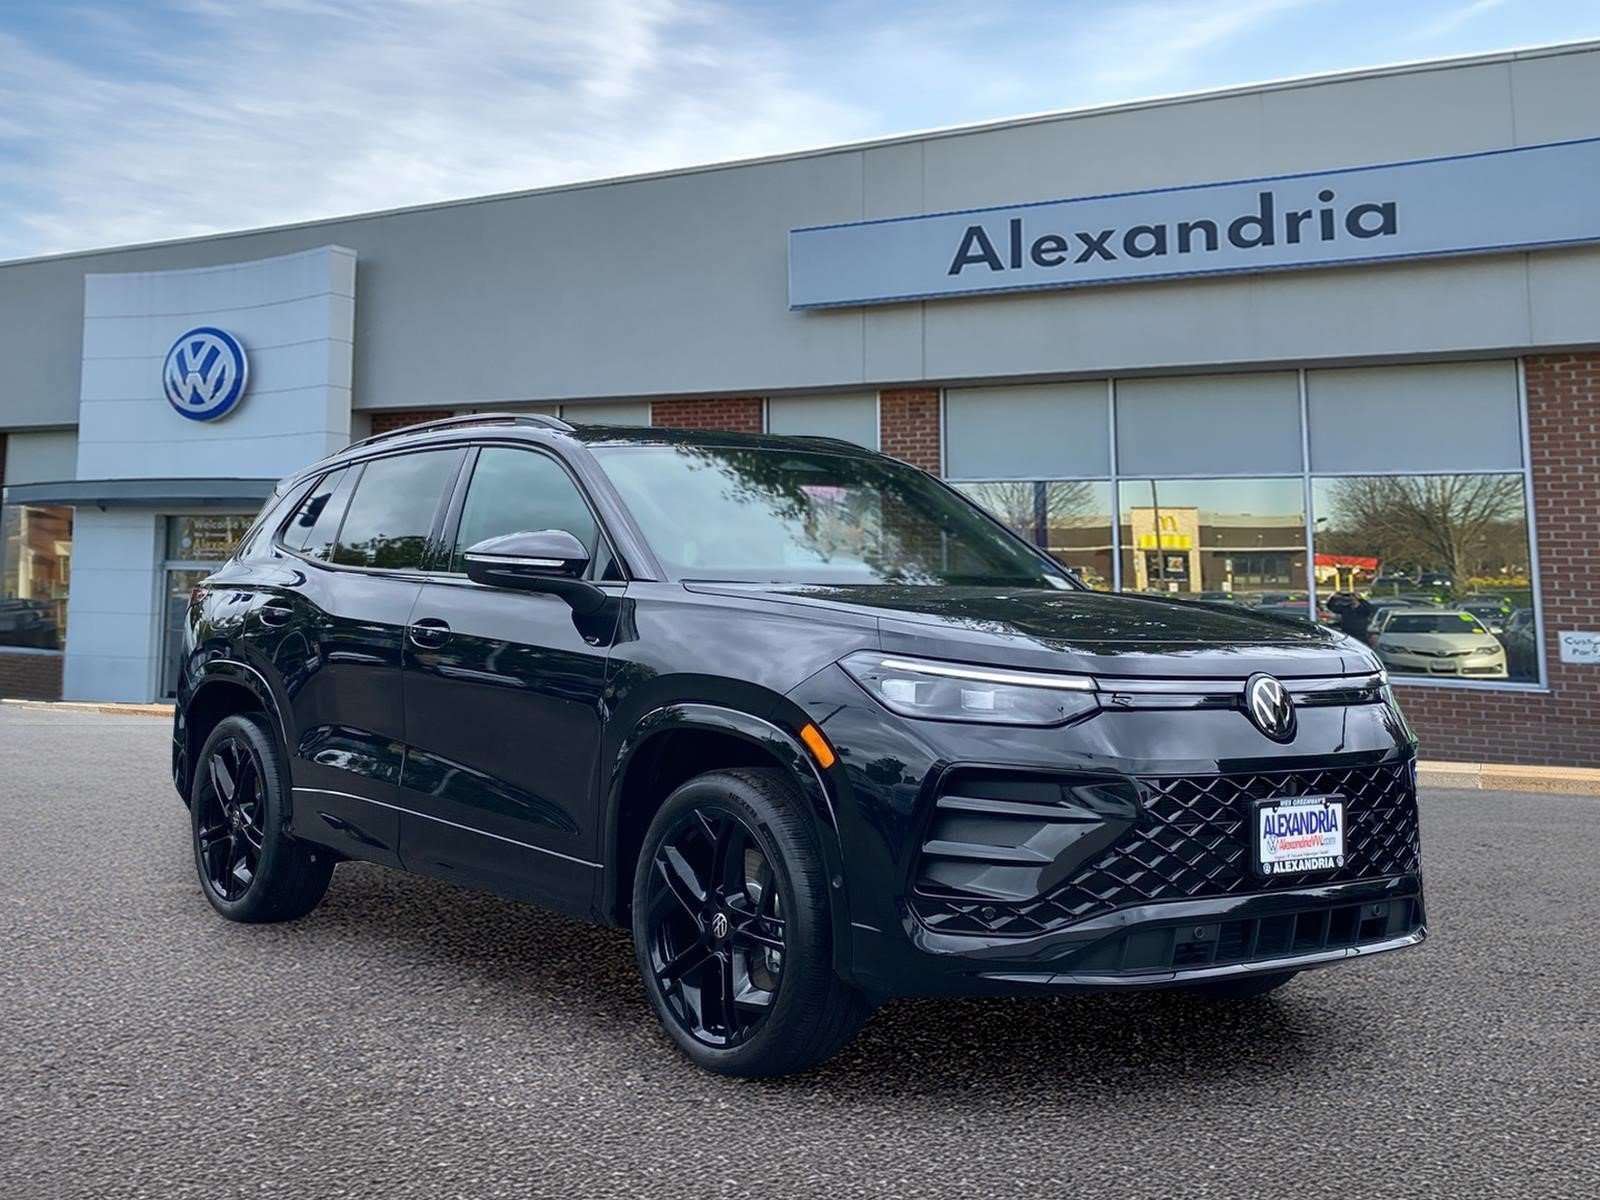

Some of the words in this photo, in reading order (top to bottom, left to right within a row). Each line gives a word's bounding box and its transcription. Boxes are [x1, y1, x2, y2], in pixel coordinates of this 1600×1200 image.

[947, 189, 1398, 276] Alexandria
[166, 332, 237, 413] VW
[1263, 808, 1339, 838] ALEXANDRIA
[1273, 856, 1335, 874] ALEXANDRIA
